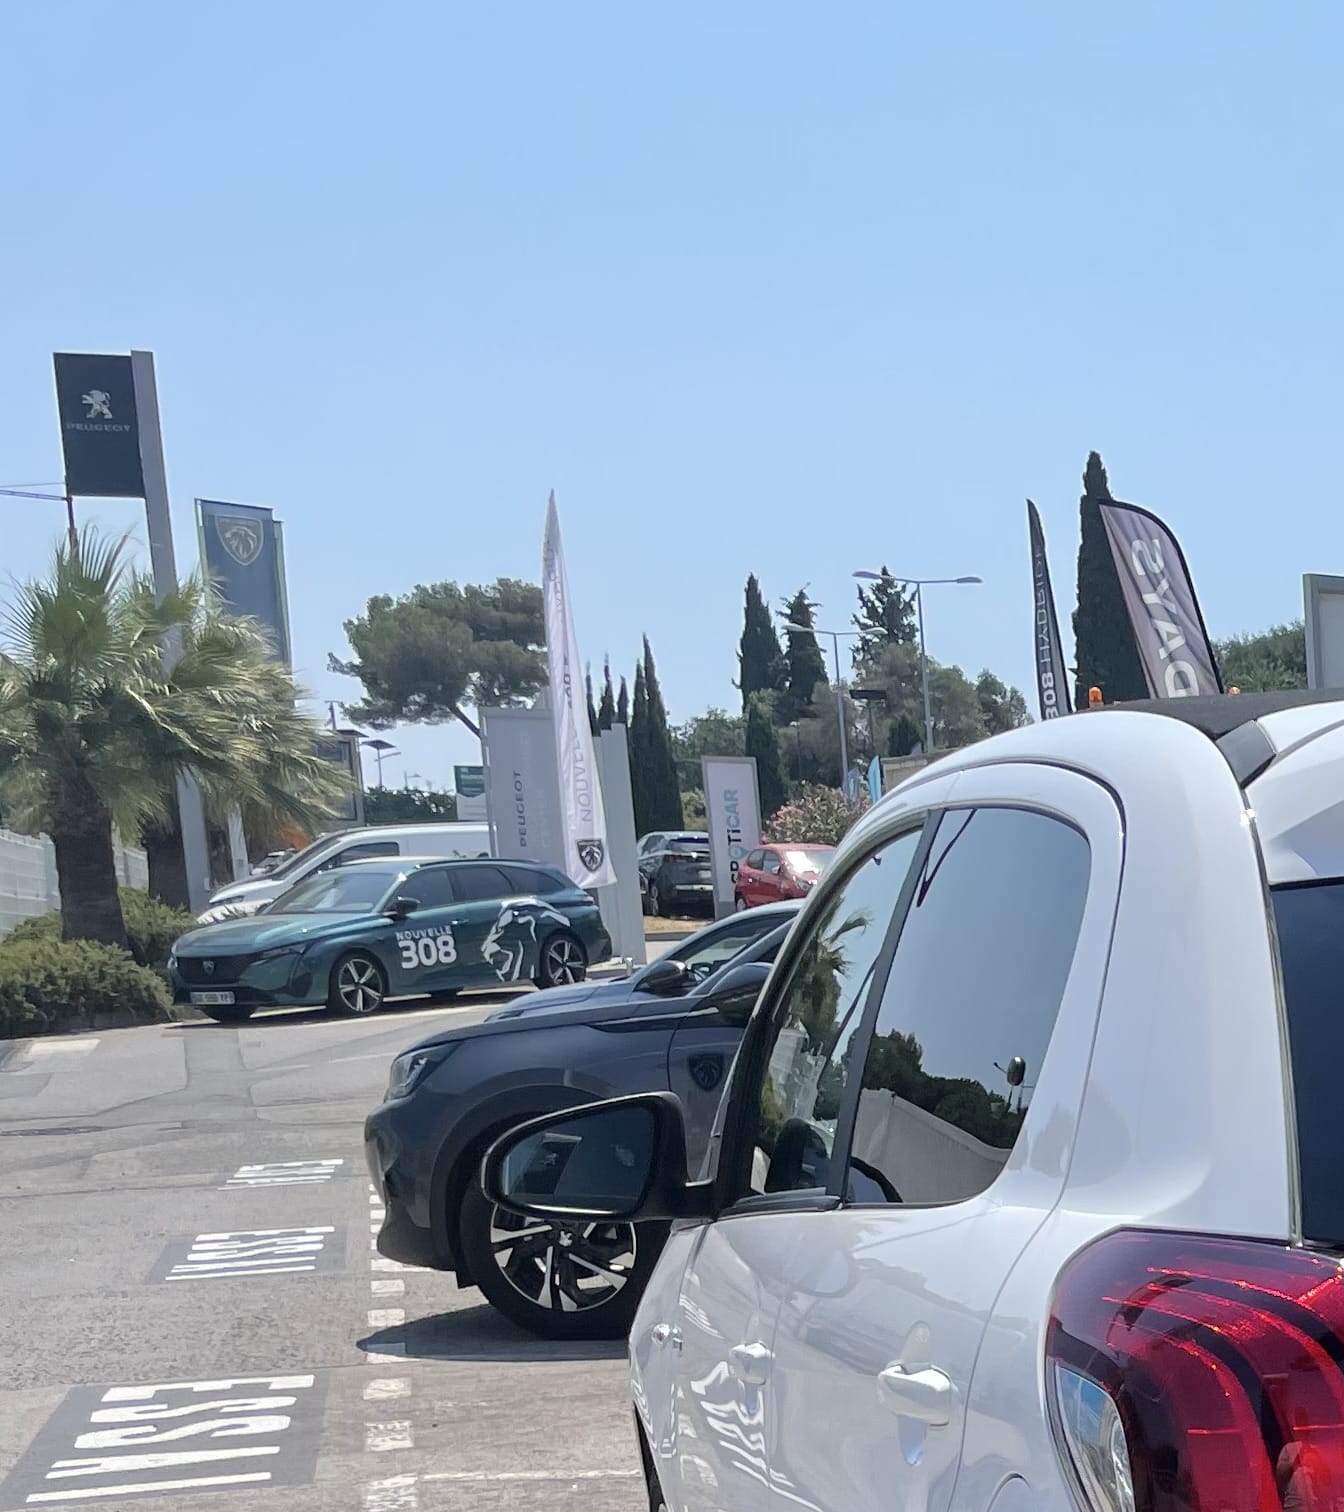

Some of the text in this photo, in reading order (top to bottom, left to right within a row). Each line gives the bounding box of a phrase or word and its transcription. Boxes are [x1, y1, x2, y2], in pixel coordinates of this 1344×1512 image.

[513, 769, 529, 849] PEUGEOT
[396, 925, 453, 941] NOUVELLE
[399, 935, 457, 969] 308
[26, 1374, 314, 1503] ESSAI
